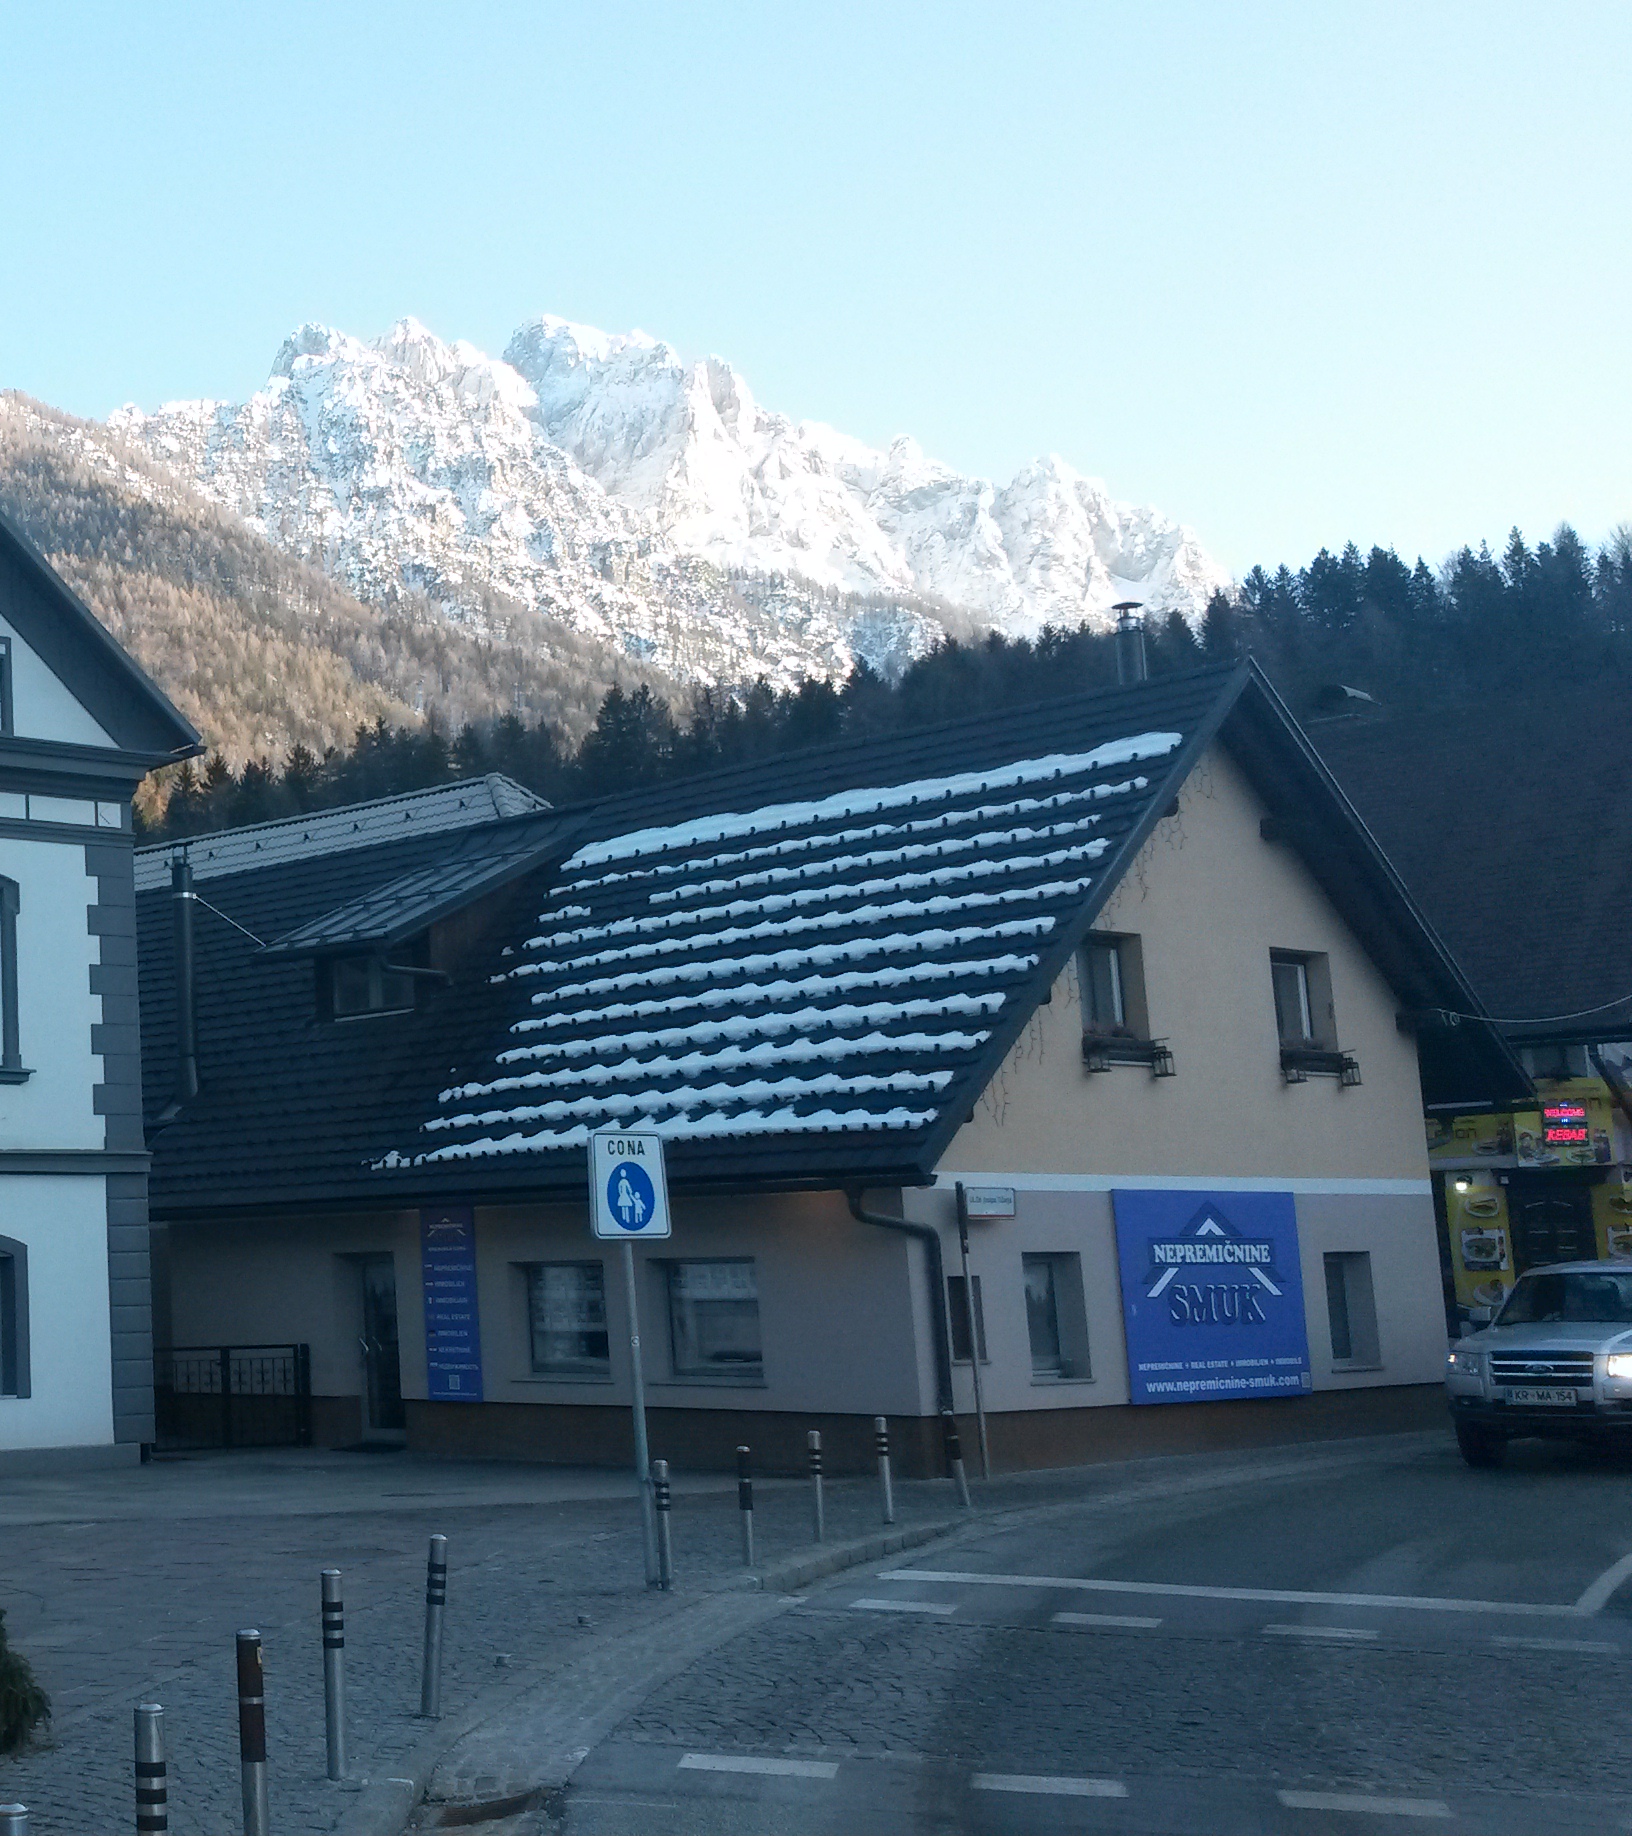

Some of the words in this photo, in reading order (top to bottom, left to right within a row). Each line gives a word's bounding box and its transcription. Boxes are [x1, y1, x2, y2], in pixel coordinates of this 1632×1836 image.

[607, 1139, 646, 1156] CONA
[1152, 1239, 1271, 1264] NEPREMIČNINE
[1170, 1283, 1267, 1325] SMUK
[1146, 1373, 1300, 1394] www.nepremicnine-smuk.com
